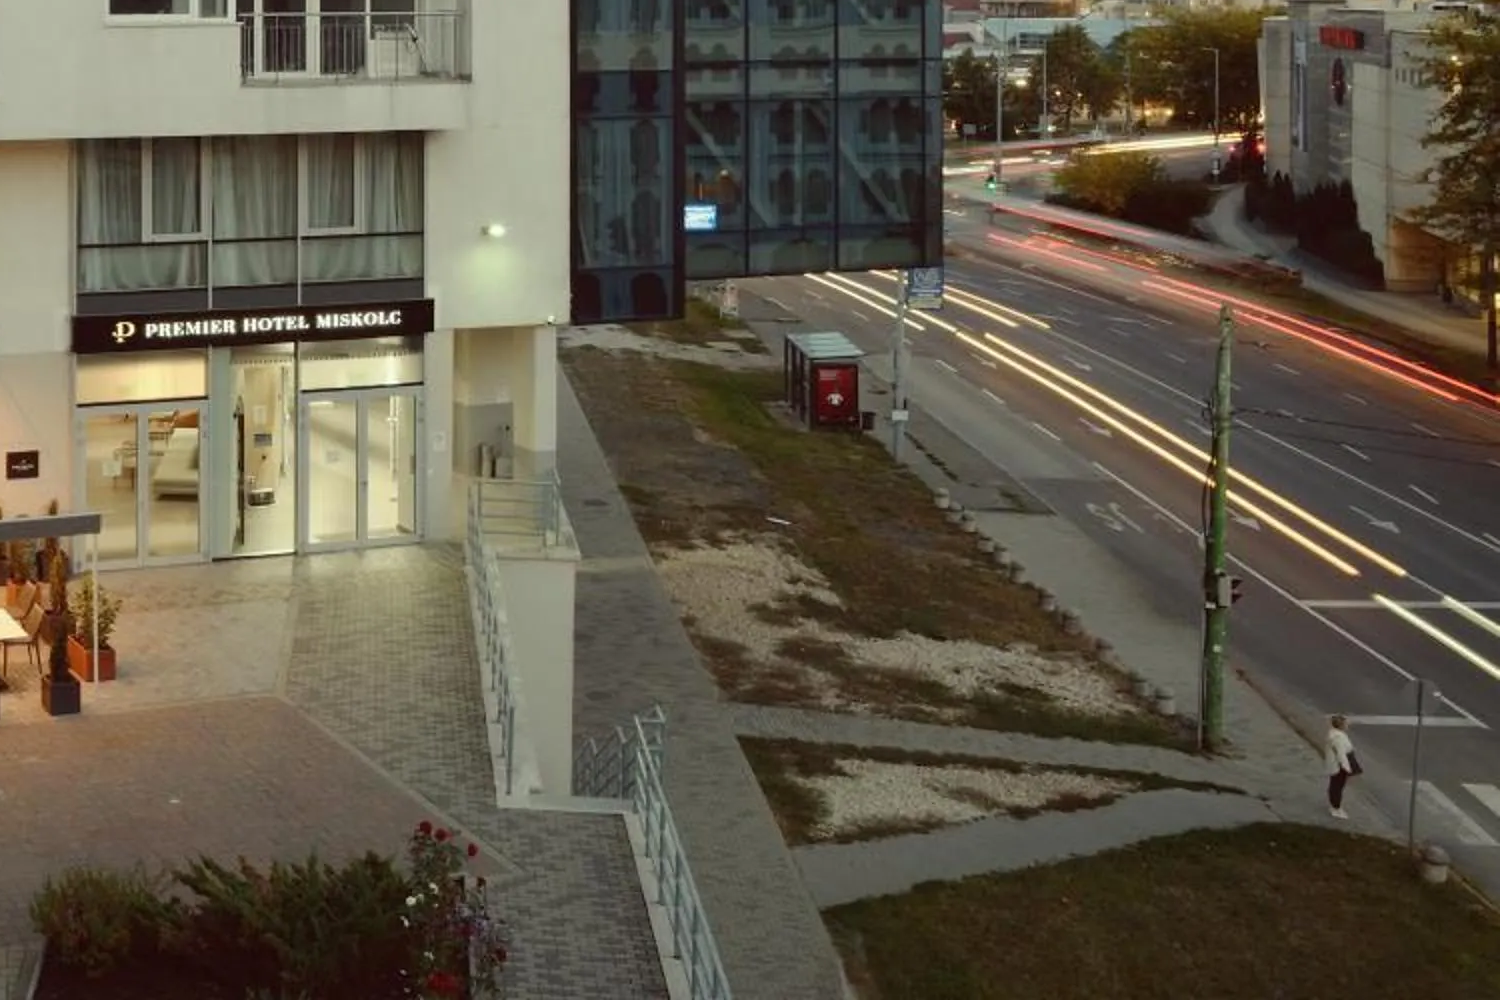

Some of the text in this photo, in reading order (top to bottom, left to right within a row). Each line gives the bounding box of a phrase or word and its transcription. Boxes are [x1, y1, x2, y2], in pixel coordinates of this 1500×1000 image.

[144, 318, 236, 339] PREMIER
[243, 314, 310, 333] HOTEL
[315, 309, 402, 329] MISKOLC
